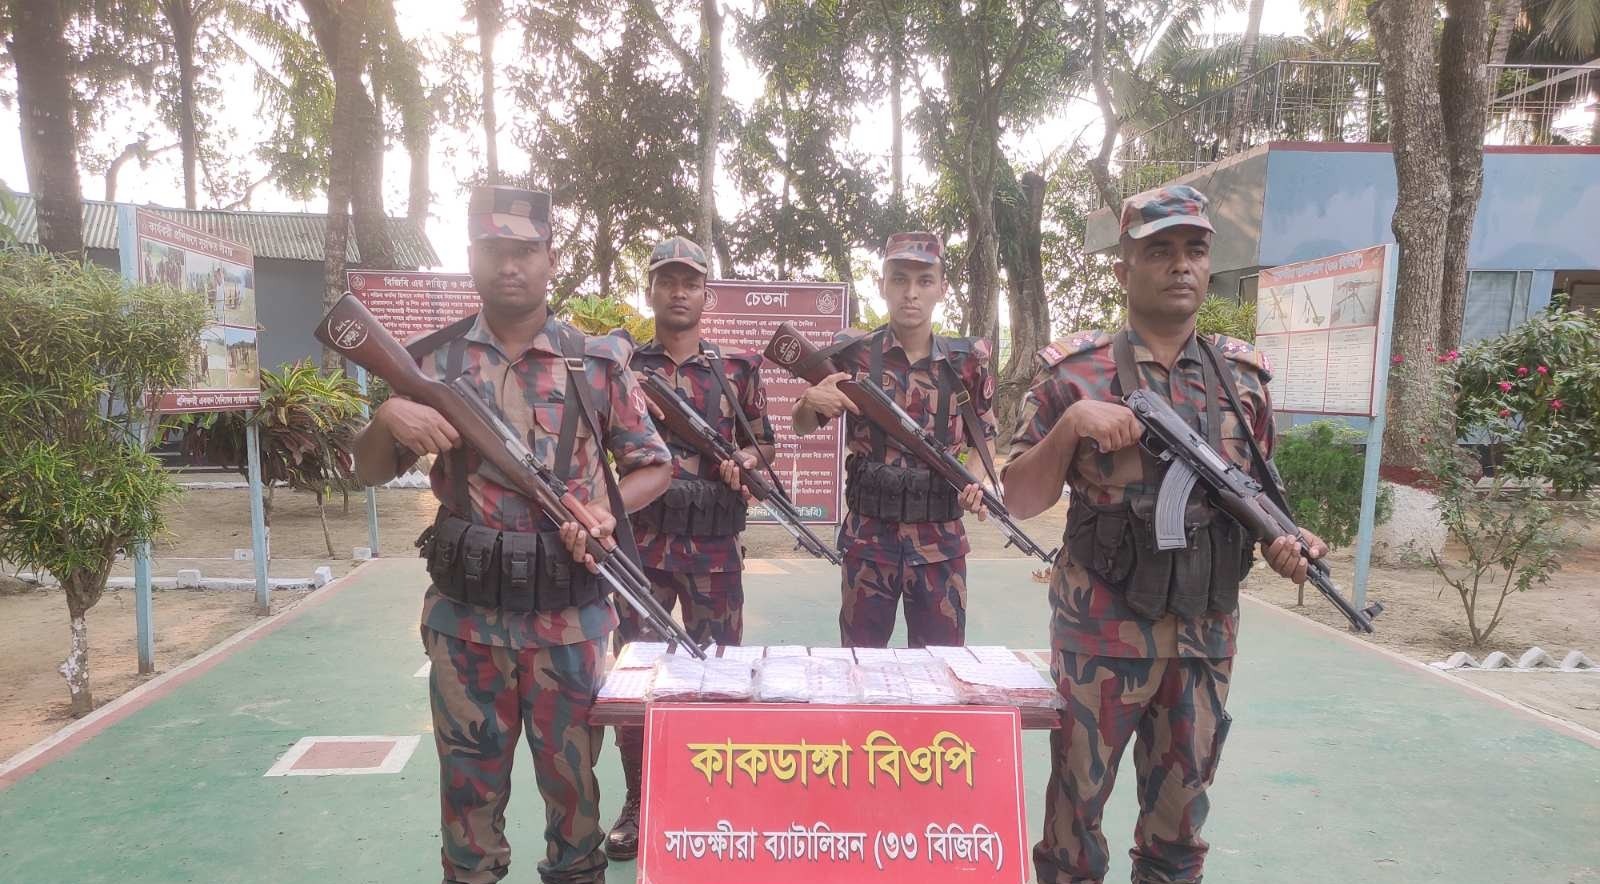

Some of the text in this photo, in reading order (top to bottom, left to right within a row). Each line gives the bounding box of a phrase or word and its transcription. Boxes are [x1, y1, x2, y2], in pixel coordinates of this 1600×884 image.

[384, 276, 409, 288] বিজিবি
[411, 279, 423, 288] এর
[426, 277, 448, 290] দায়িত্ব
[745, 291, 789, 307] চেতনা
[687, 730, 977, 788] কাকডাঙ্গা বিওপি
[664, 820, 1004, 870] সাতক্ষীরা ব্যাটালিয়ন (৩৩ বিজিবি)
